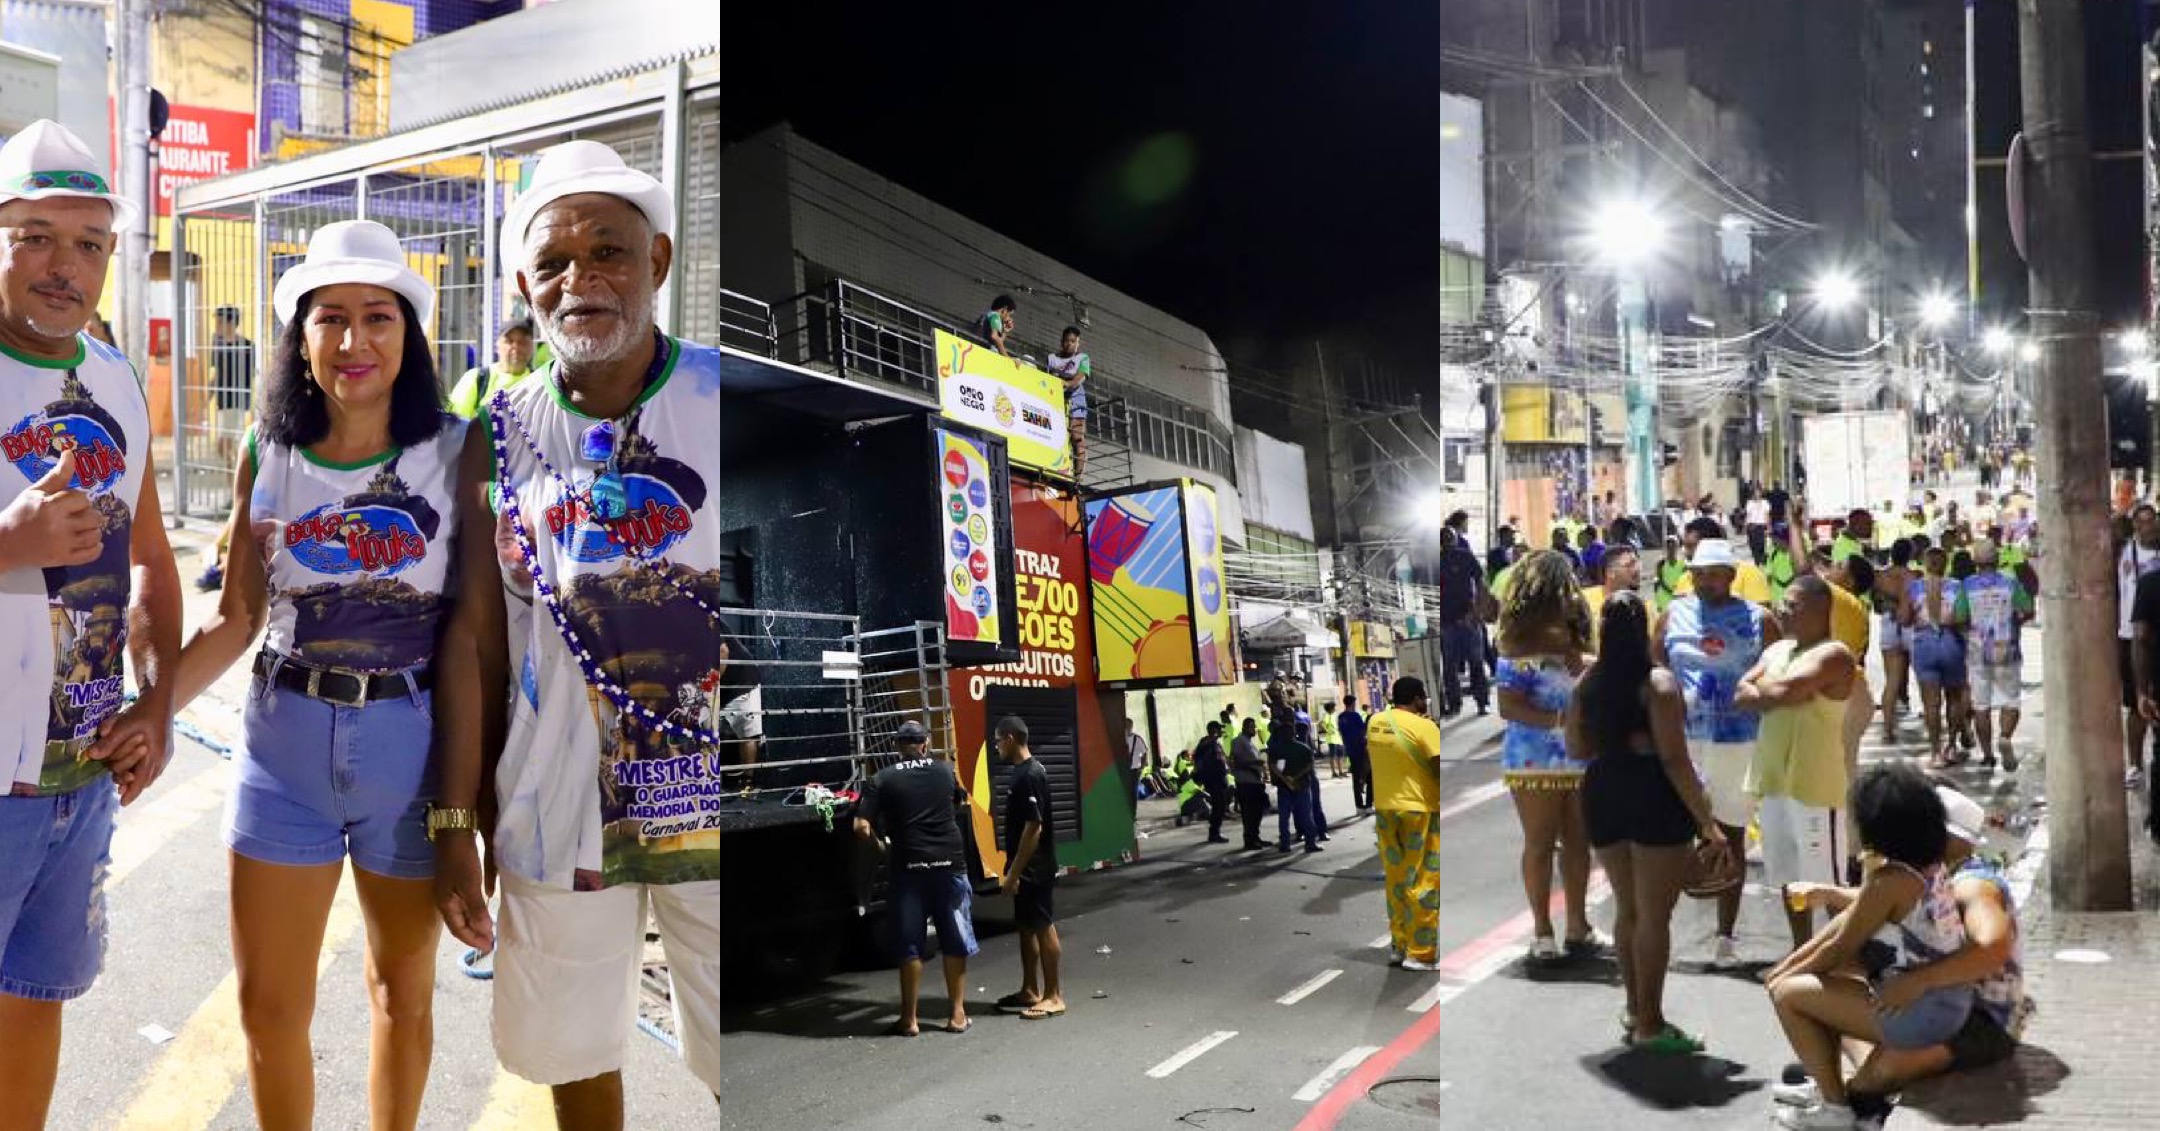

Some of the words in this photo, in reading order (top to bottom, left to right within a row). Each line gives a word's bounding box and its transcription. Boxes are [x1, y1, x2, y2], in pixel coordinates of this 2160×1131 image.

[1015, 549, 1061, 579] TRAZ
[896, 758, 934, 770] STAFF
[629, 801, 696, 819] MEMORIA
[700, 799, 720, 811] DO
[642, 817, 701, 837] Carnaval
